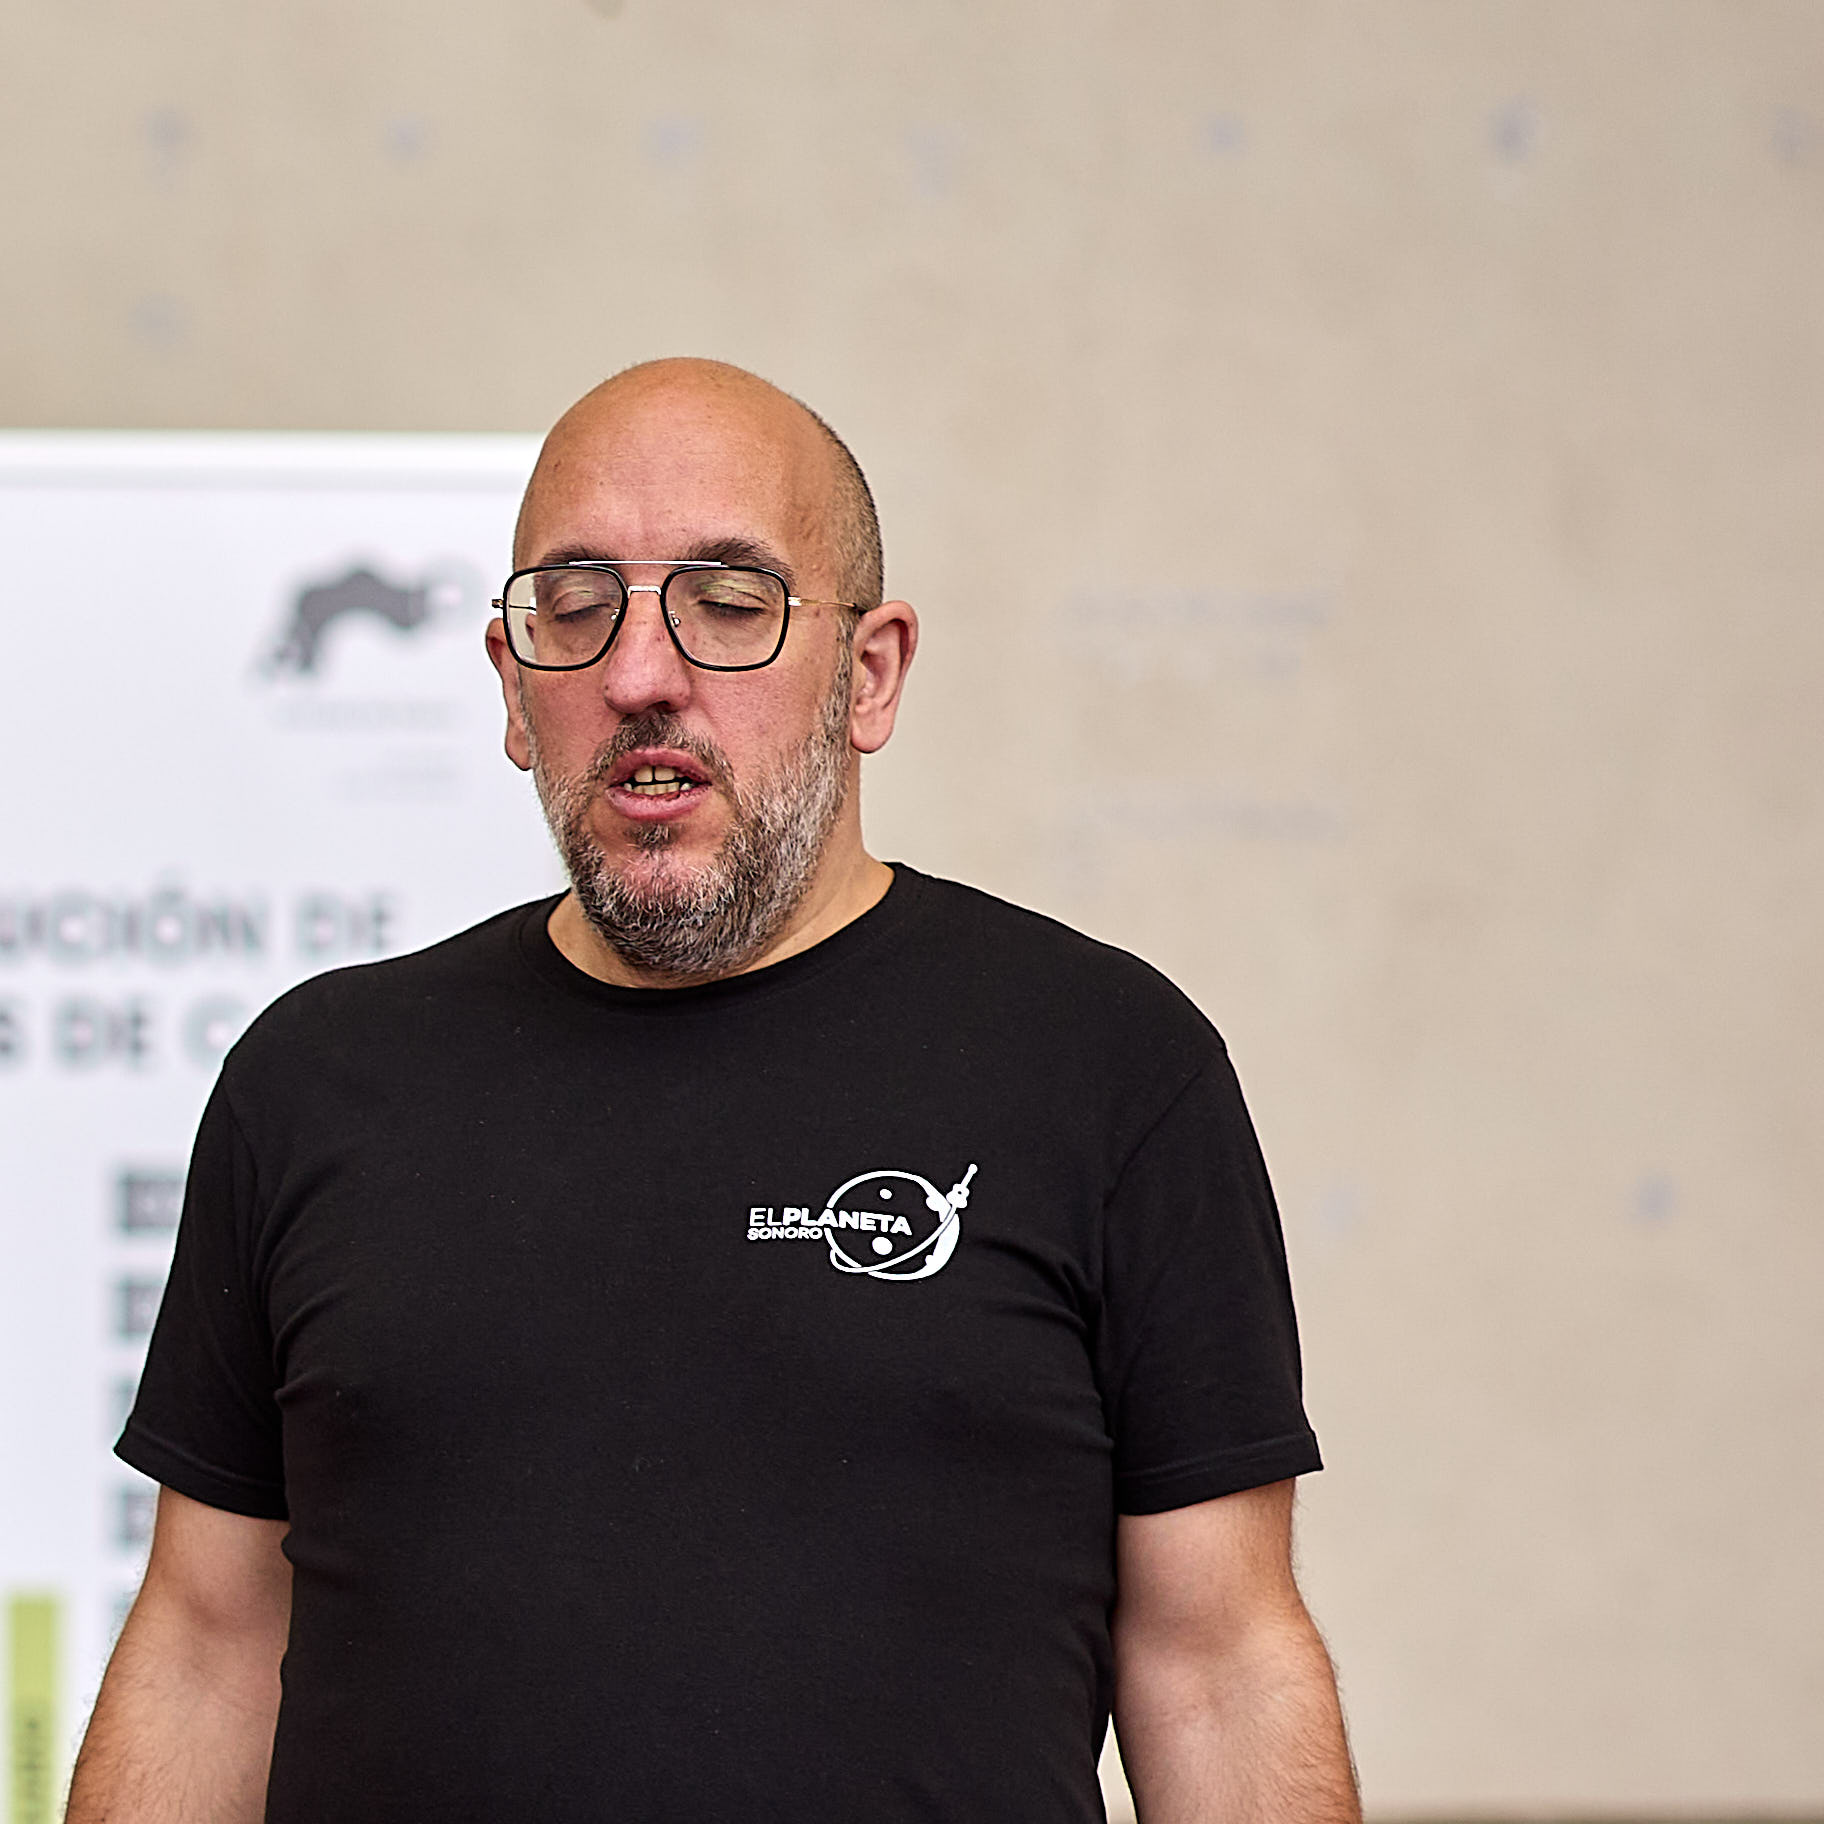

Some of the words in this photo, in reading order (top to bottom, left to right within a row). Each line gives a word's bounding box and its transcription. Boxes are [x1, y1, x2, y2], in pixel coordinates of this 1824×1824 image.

[297, 892, 394, 962] DE
[54, 997, 152, 1070] DE
[746, 1226, 824, 1241] SONORO
